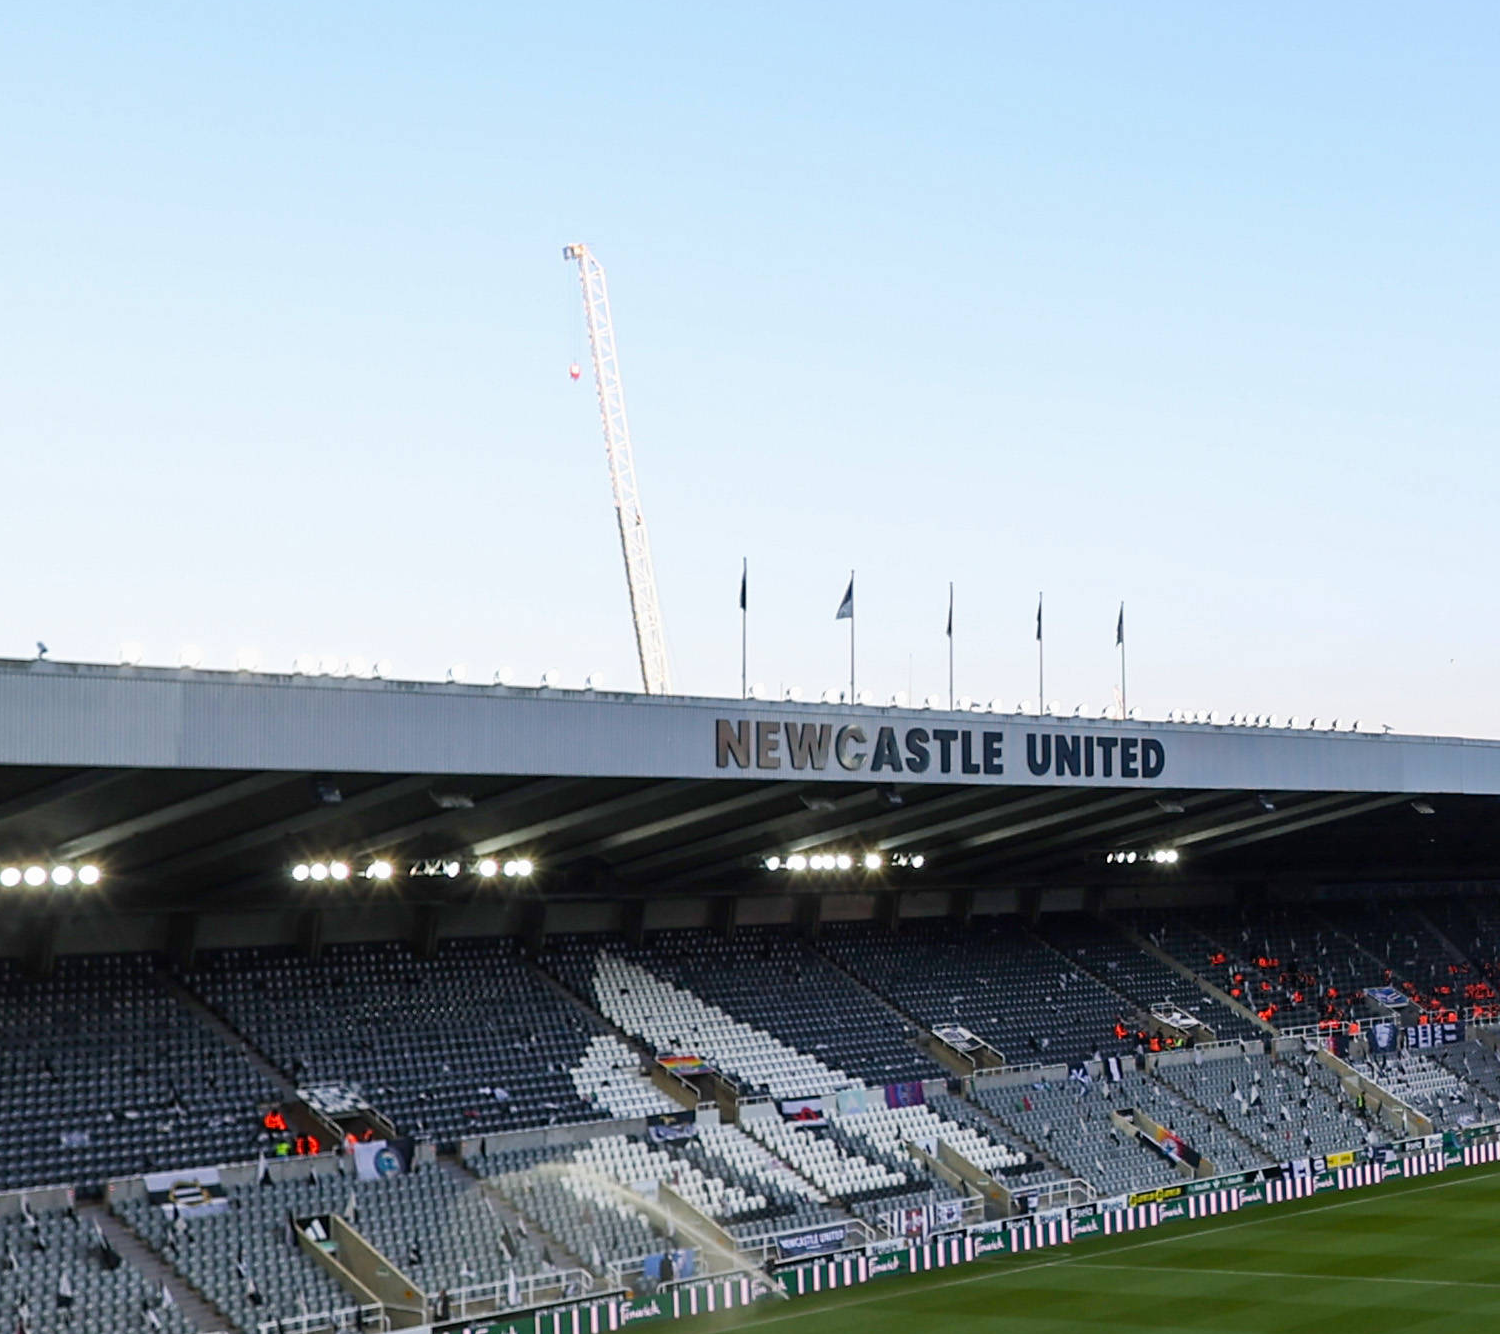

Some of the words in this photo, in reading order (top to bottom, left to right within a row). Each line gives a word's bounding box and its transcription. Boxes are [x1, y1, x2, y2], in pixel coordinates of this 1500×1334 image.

[714, 718, 1004, 776] NEWCASTLE
[1026, 733, 1165, 780] UNITED
[620, 1299, 661, 1325] Fenwick
